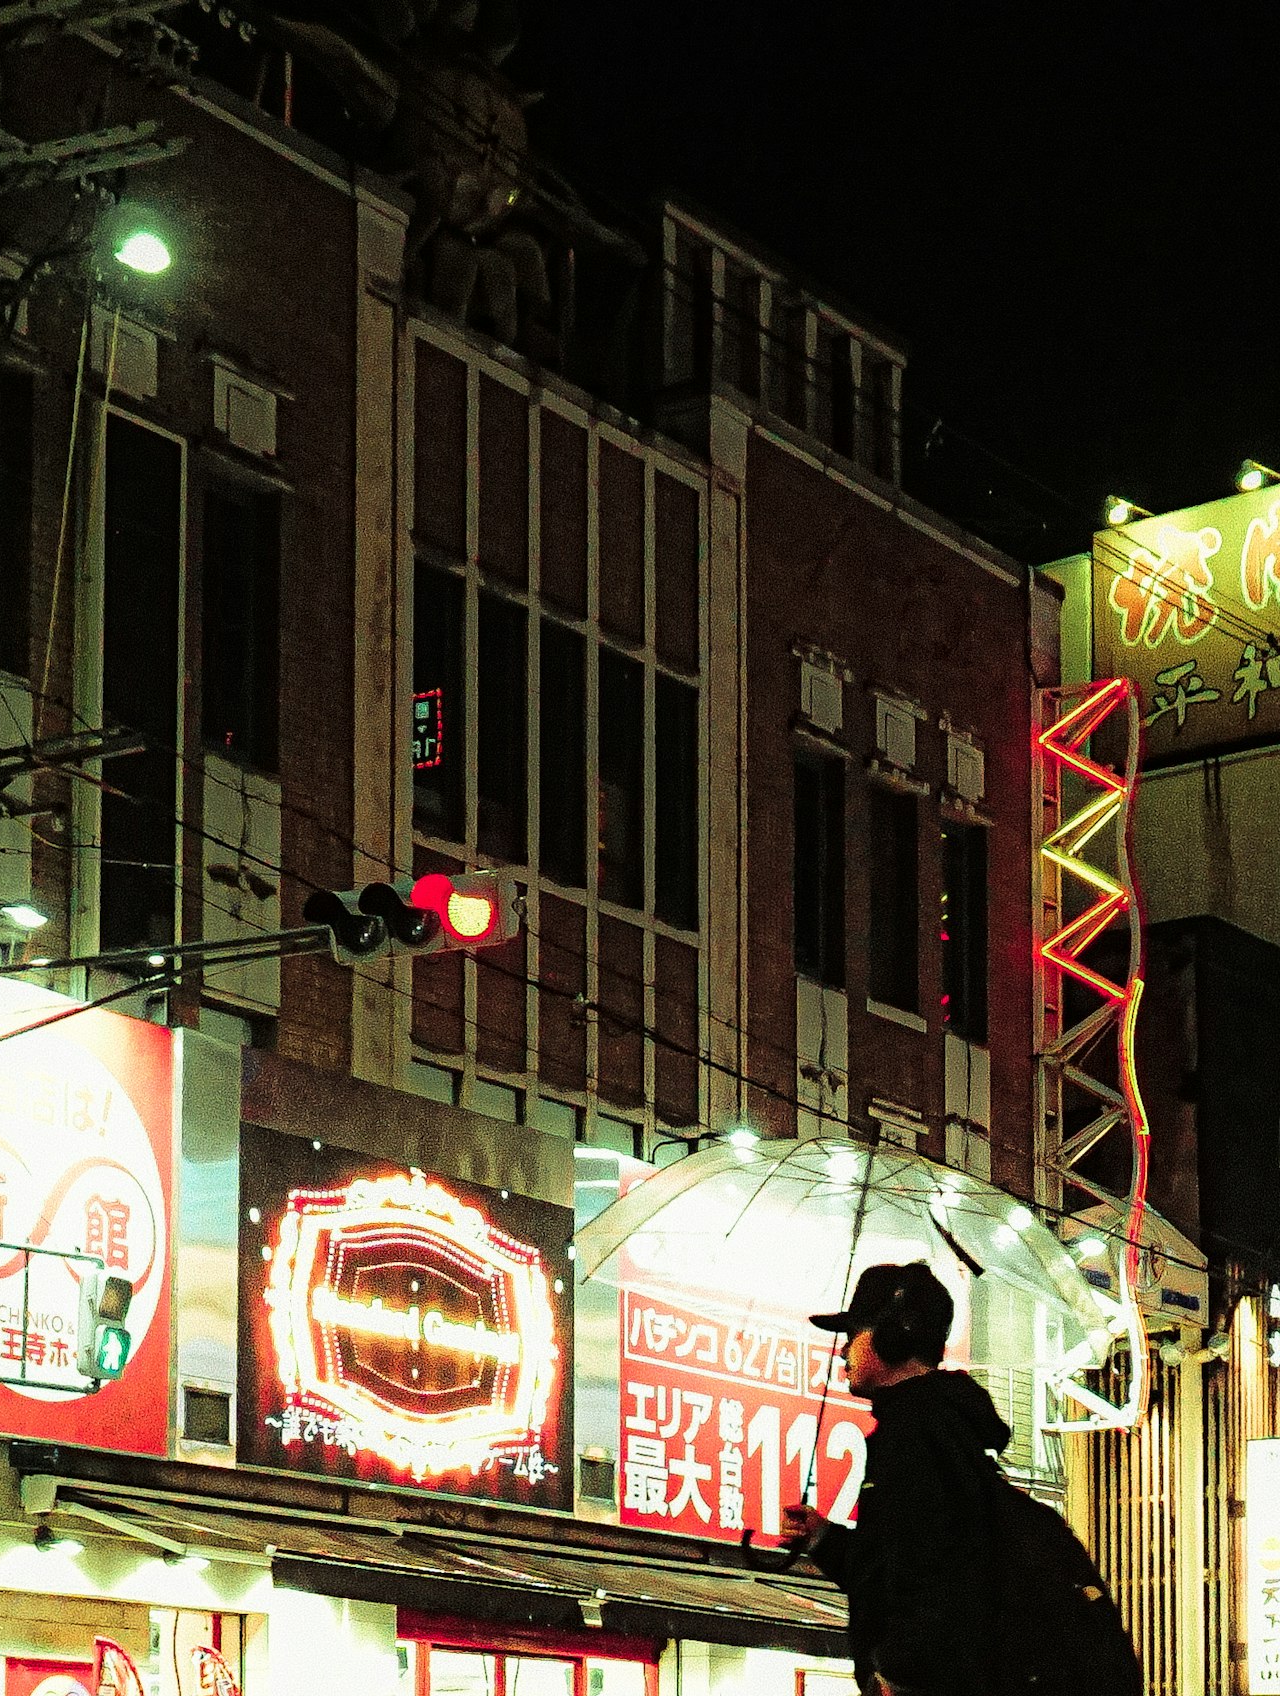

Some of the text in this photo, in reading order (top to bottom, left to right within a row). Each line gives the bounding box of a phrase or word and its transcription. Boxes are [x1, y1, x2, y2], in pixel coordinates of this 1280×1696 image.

[629, 1306, 718, 1365] パチンコ
[723, 1326, 800, 1386] 627台
[624, 1379, 714, 1440] エリア
[623, 1436, 715, 1526] 最大
